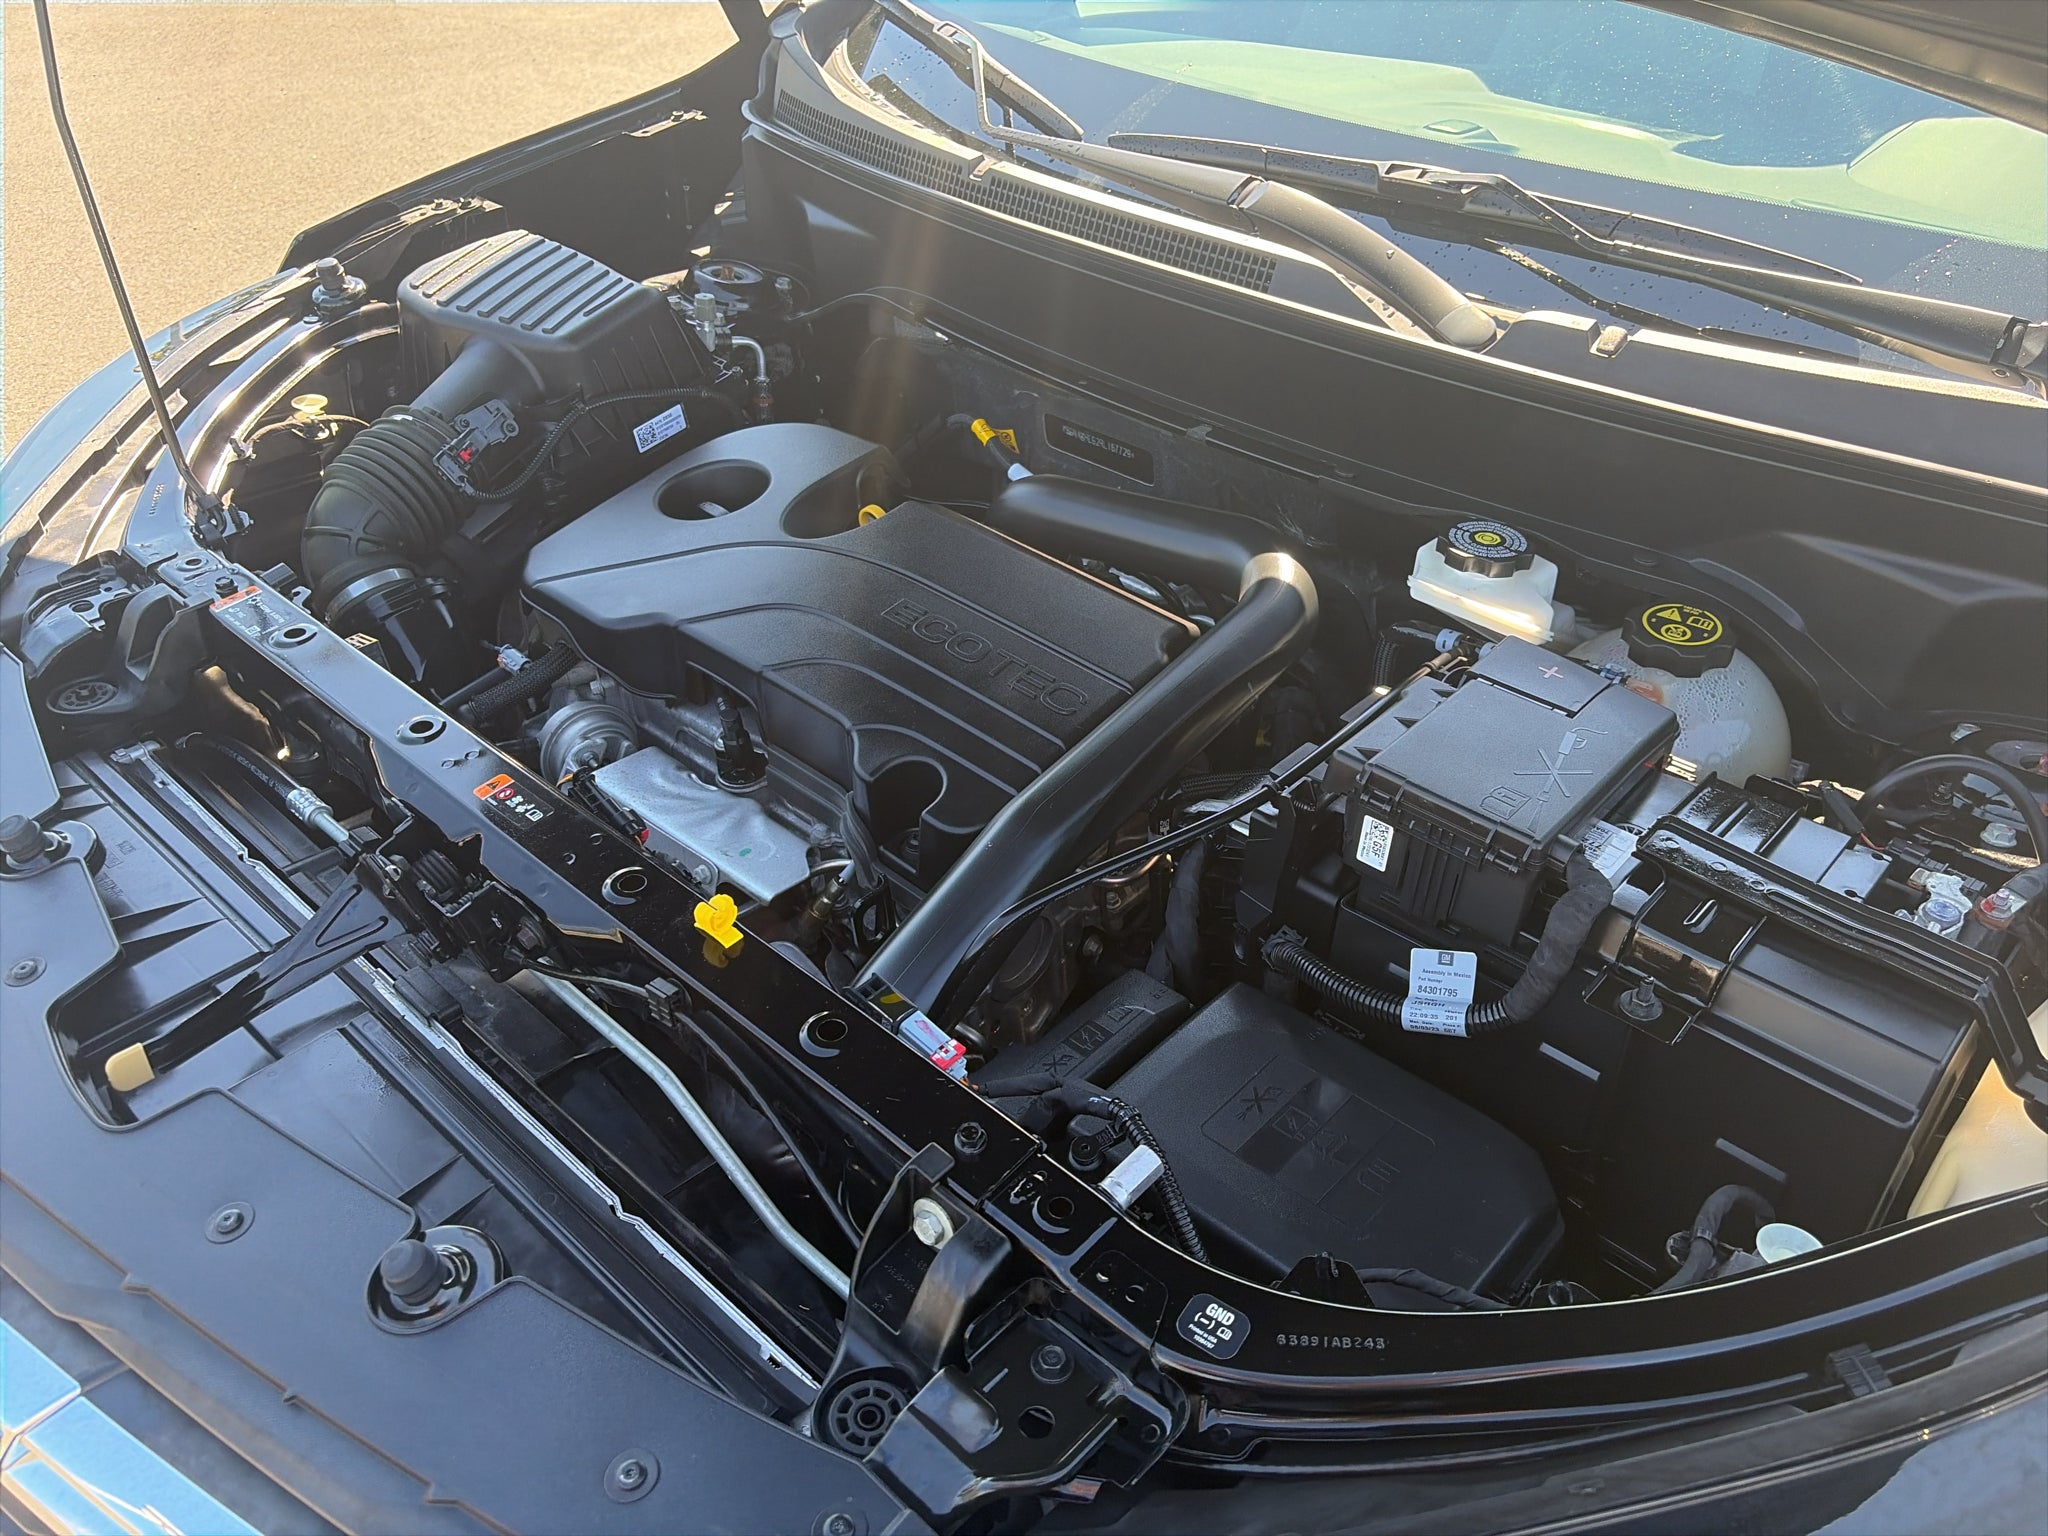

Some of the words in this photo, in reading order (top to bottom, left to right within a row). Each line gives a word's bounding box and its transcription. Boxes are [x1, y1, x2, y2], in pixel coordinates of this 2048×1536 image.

[880, 598, 1088, 716] ECOTEC
[1422, 968, 1446, 977] Assembly
[1453, 971, 1472, 979] Mexico
[1417, 984, 1458, 998] 84301795
[1409, 1011, 1439, 1020] 22:09:35
[1206, 1303, 1235, 1326] GND
[1188, 1324, 1205, 1336] Printed
[1207, 1335, 1218, 1344] USA
